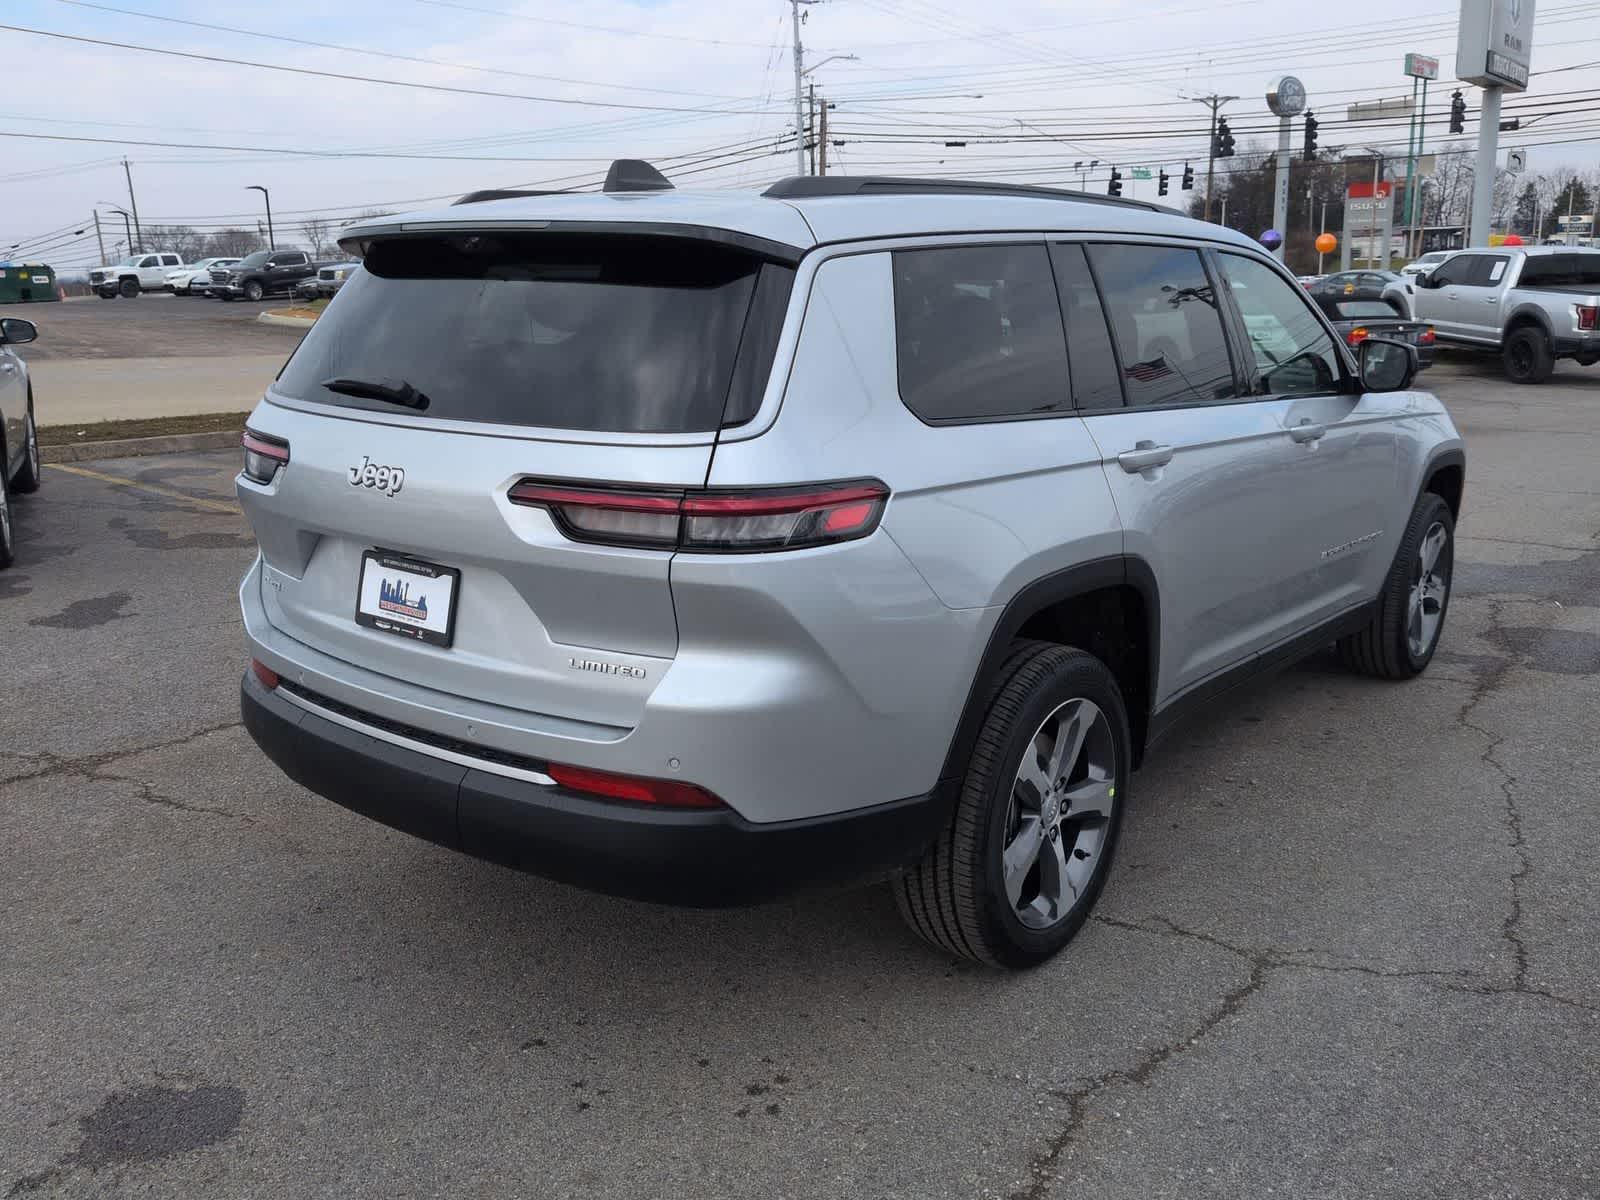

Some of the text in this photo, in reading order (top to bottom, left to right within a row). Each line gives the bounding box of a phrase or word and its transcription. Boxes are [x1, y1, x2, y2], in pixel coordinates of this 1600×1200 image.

[1504, 33, 1522, 51] RAM
[348, 456, 404, 497] Jeep
[568, 658, 646, 679] LIMITED
